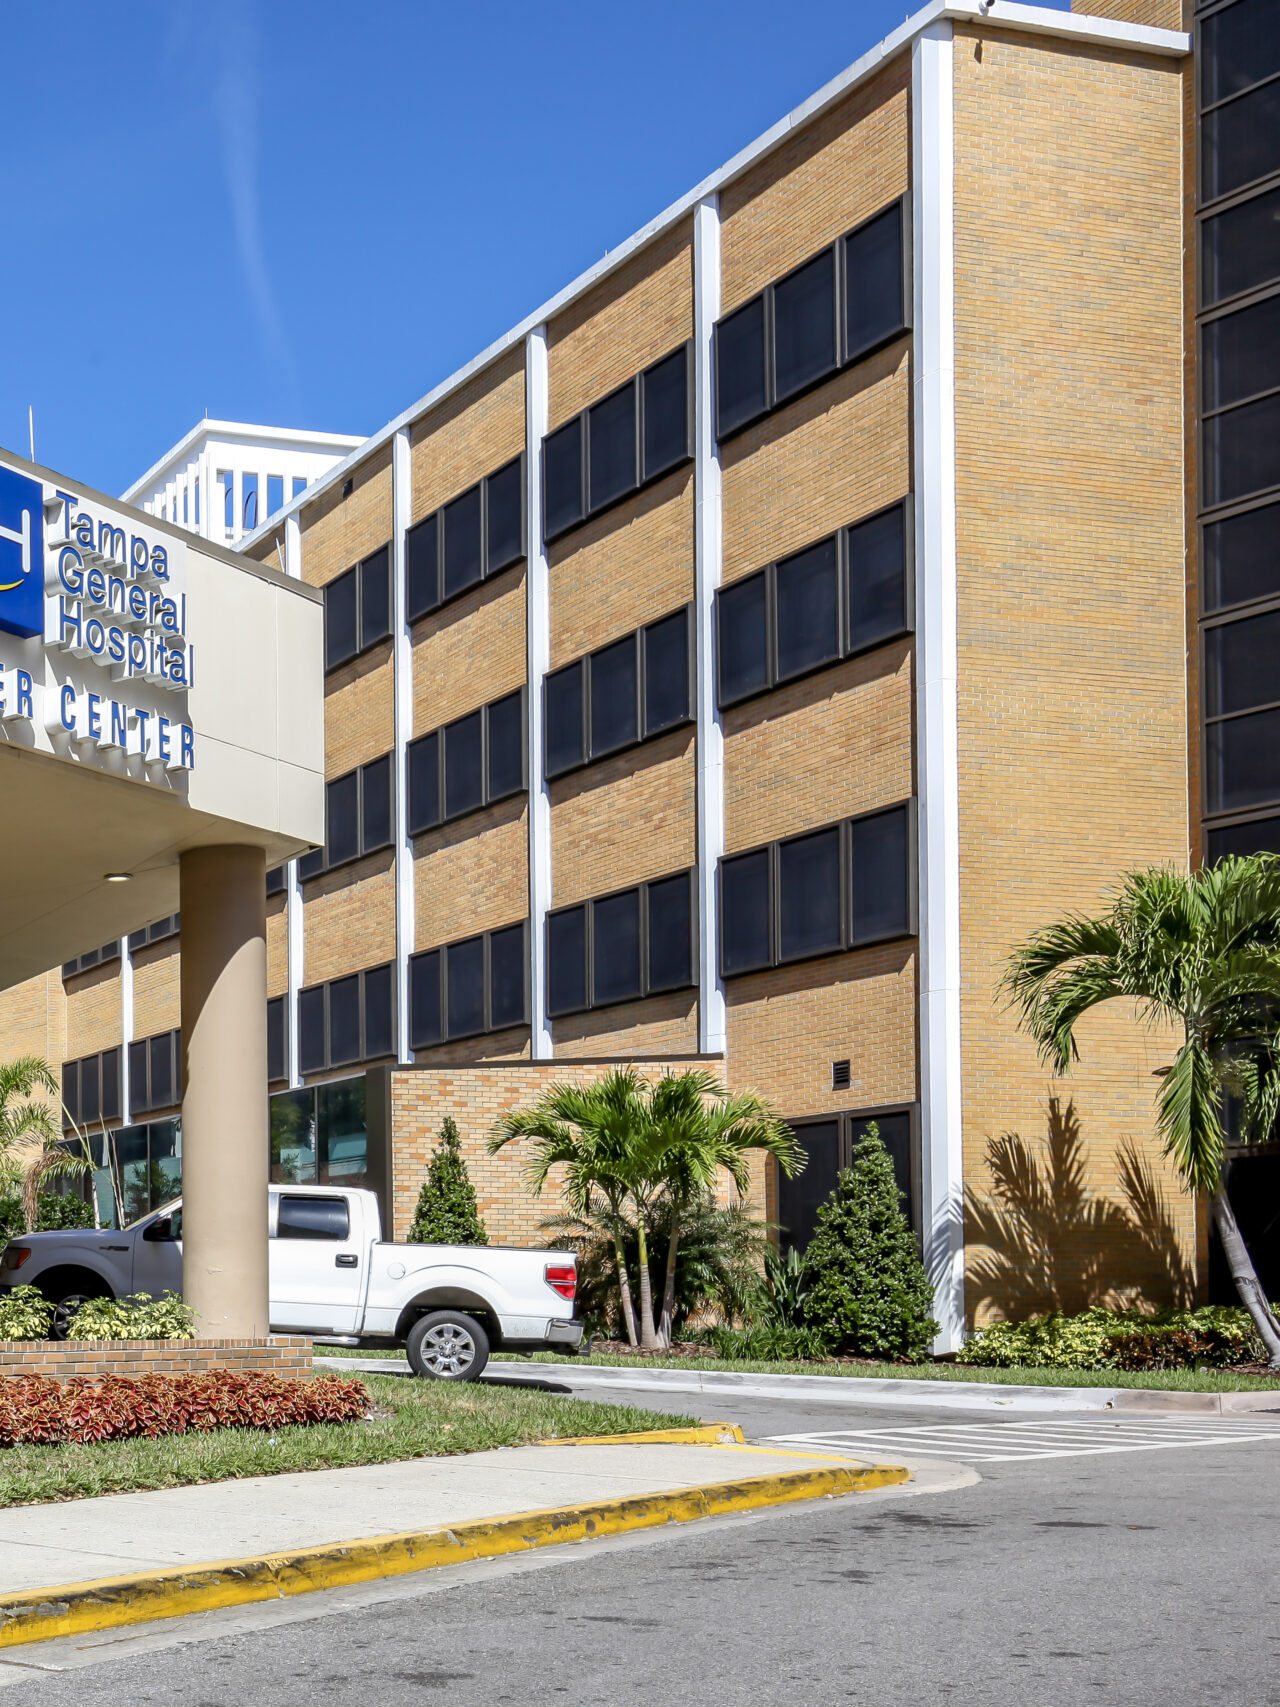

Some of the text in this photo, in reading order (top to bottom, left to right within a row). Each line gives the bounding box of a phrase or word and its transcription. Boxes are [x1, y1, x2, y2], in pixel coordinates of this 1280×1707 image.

[56, 489, 170, 581] Tampa
[58, 545, 186, 637] General
[60, 594, 195, 688] Hospital
[60, 685, 195, 771] CENTER
